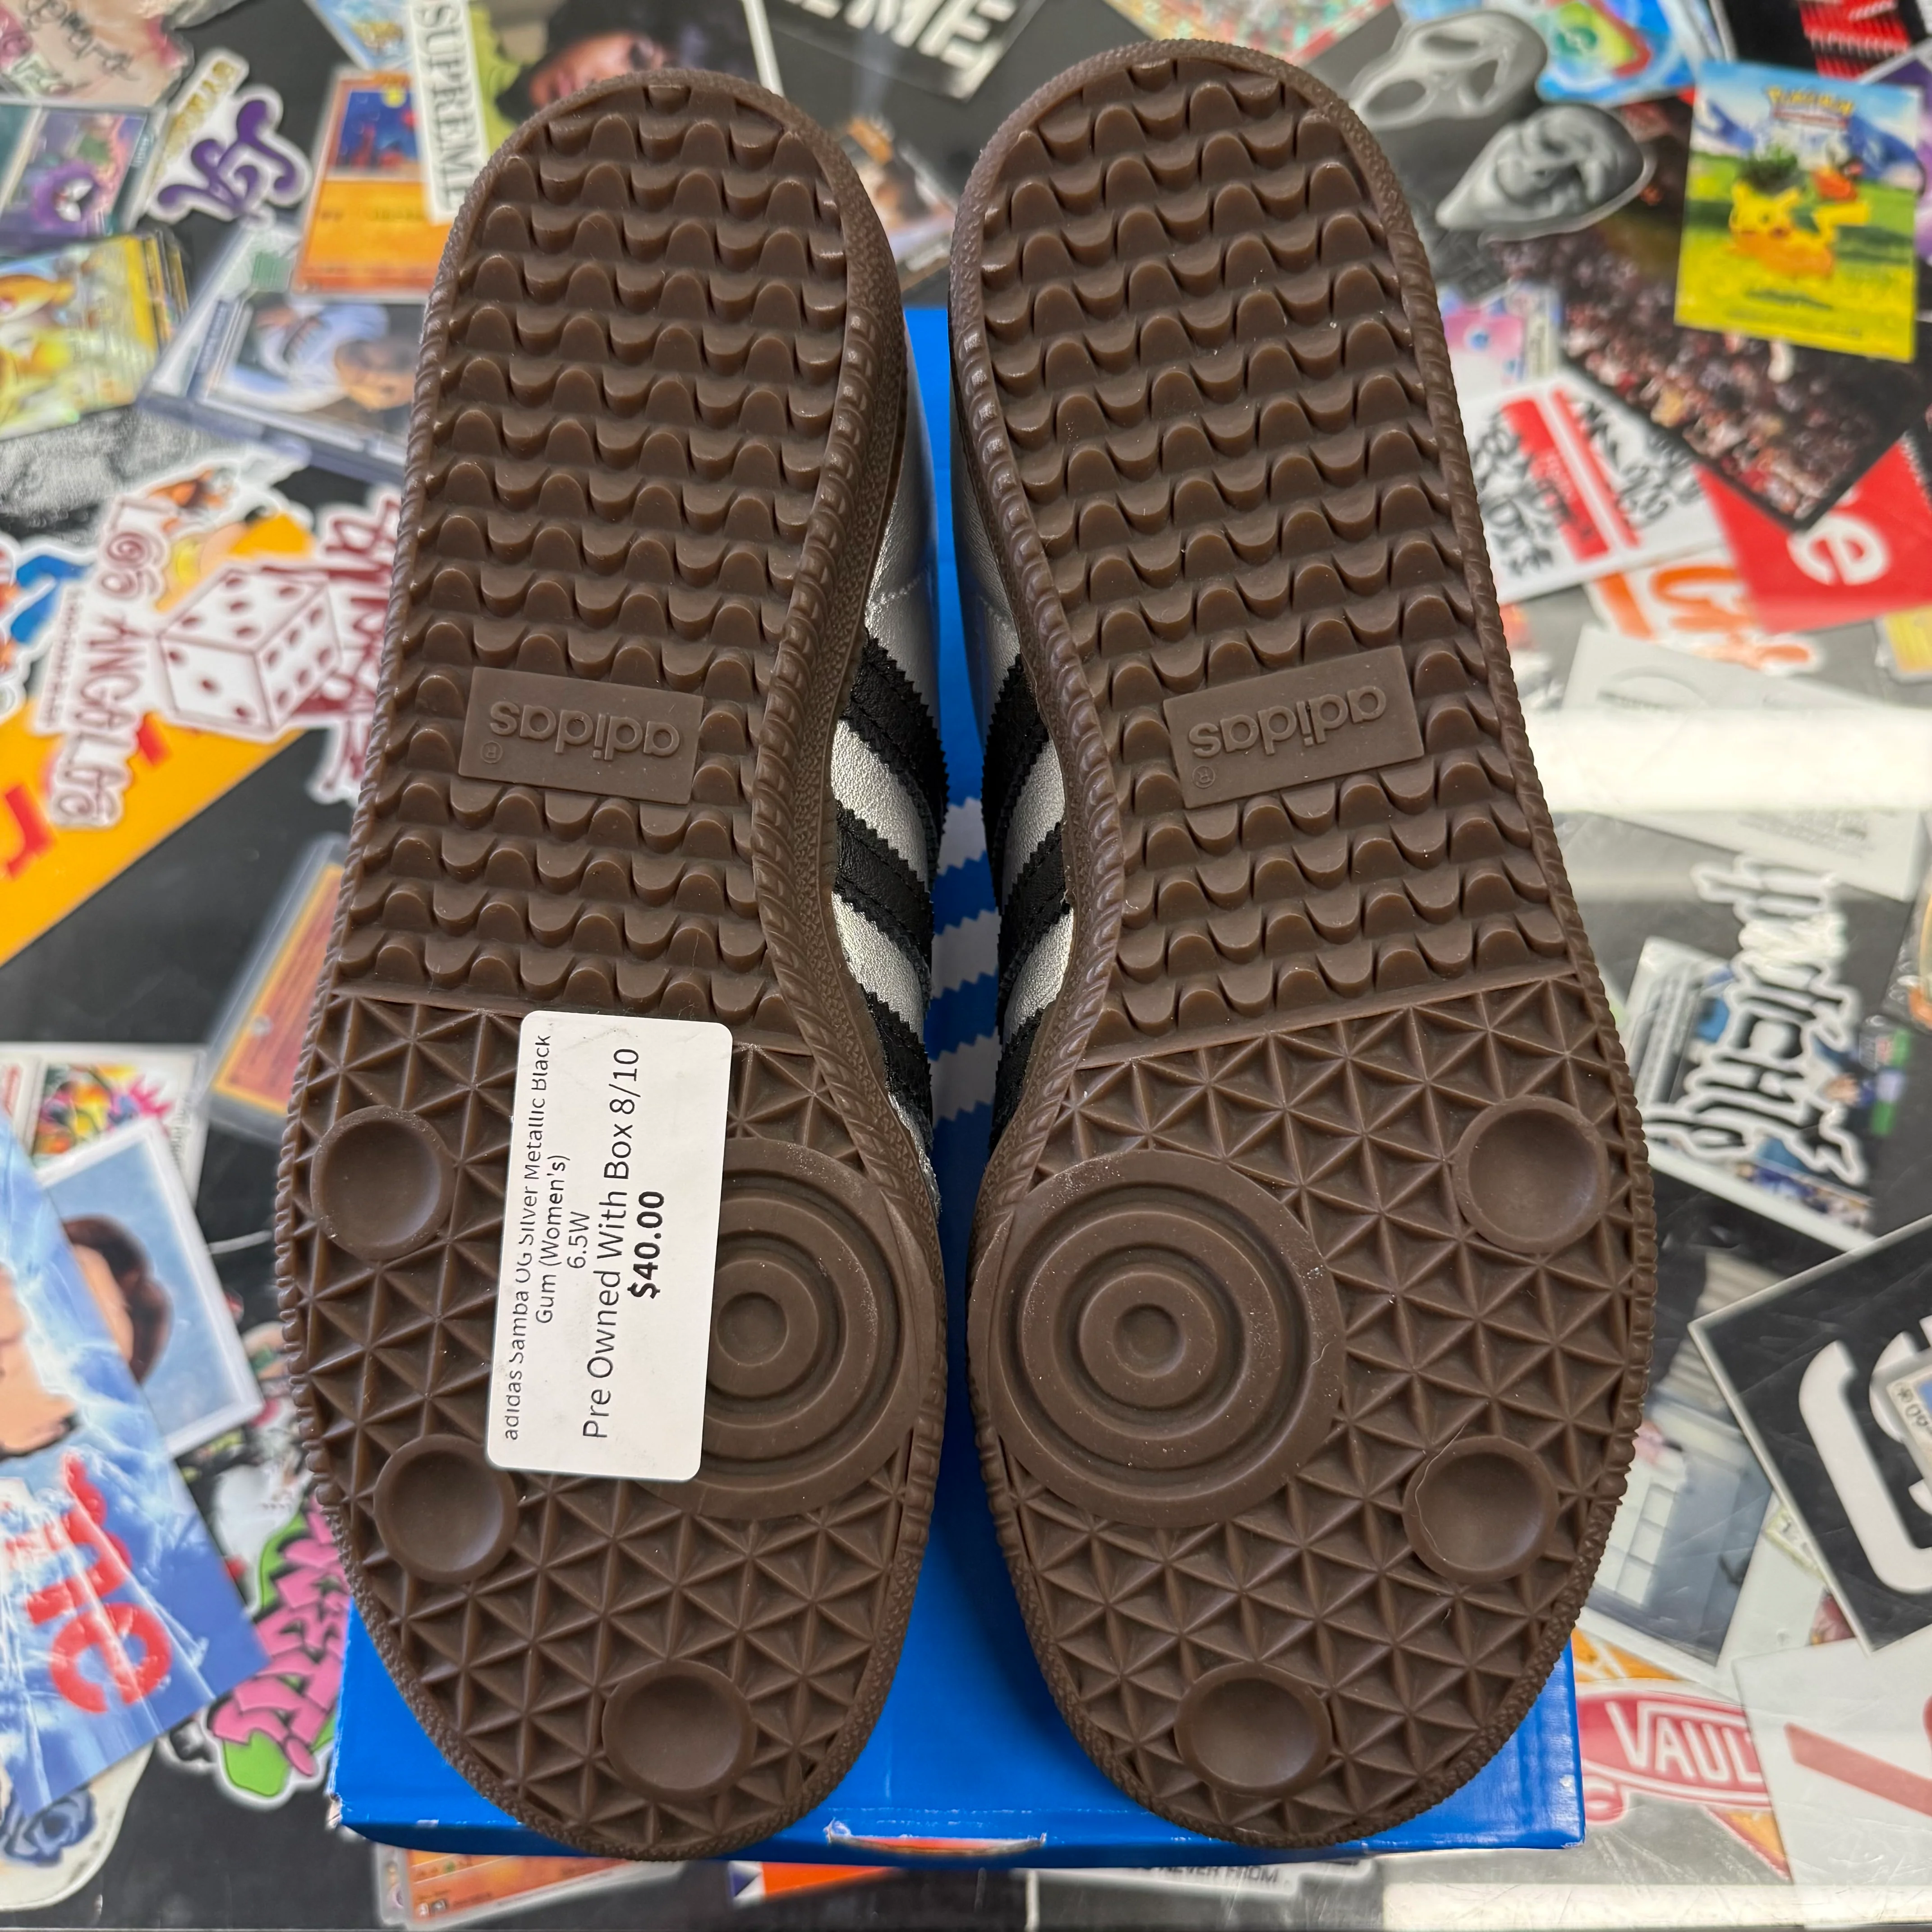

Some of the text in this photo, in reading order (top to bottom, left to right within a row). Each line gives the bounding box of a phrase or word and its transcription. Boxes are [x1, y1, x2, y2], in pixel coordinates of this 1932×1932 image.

[490, 700, 681, 762] adidas
[1188, 685, 1386, 759] adidas
[531, 1035, 551, 1091] Black
[524, 1098, 546, 1180] Metallic
[518, 1190, 538, 1246] Silver
[535, 1155, 571, 1324] Gum (Women's)
[566, 1211, 590, 1269] 6.5W
[582, 1049, 641, 1438] Pre Owned With Box 8/10
[626, 1191, 665, 1300] $40.00
[508, 1291, 529, 1364] Samba
[504, 1371, 522, 1440] adidas
[1605, 1698, 1764, 1785] VAUL
